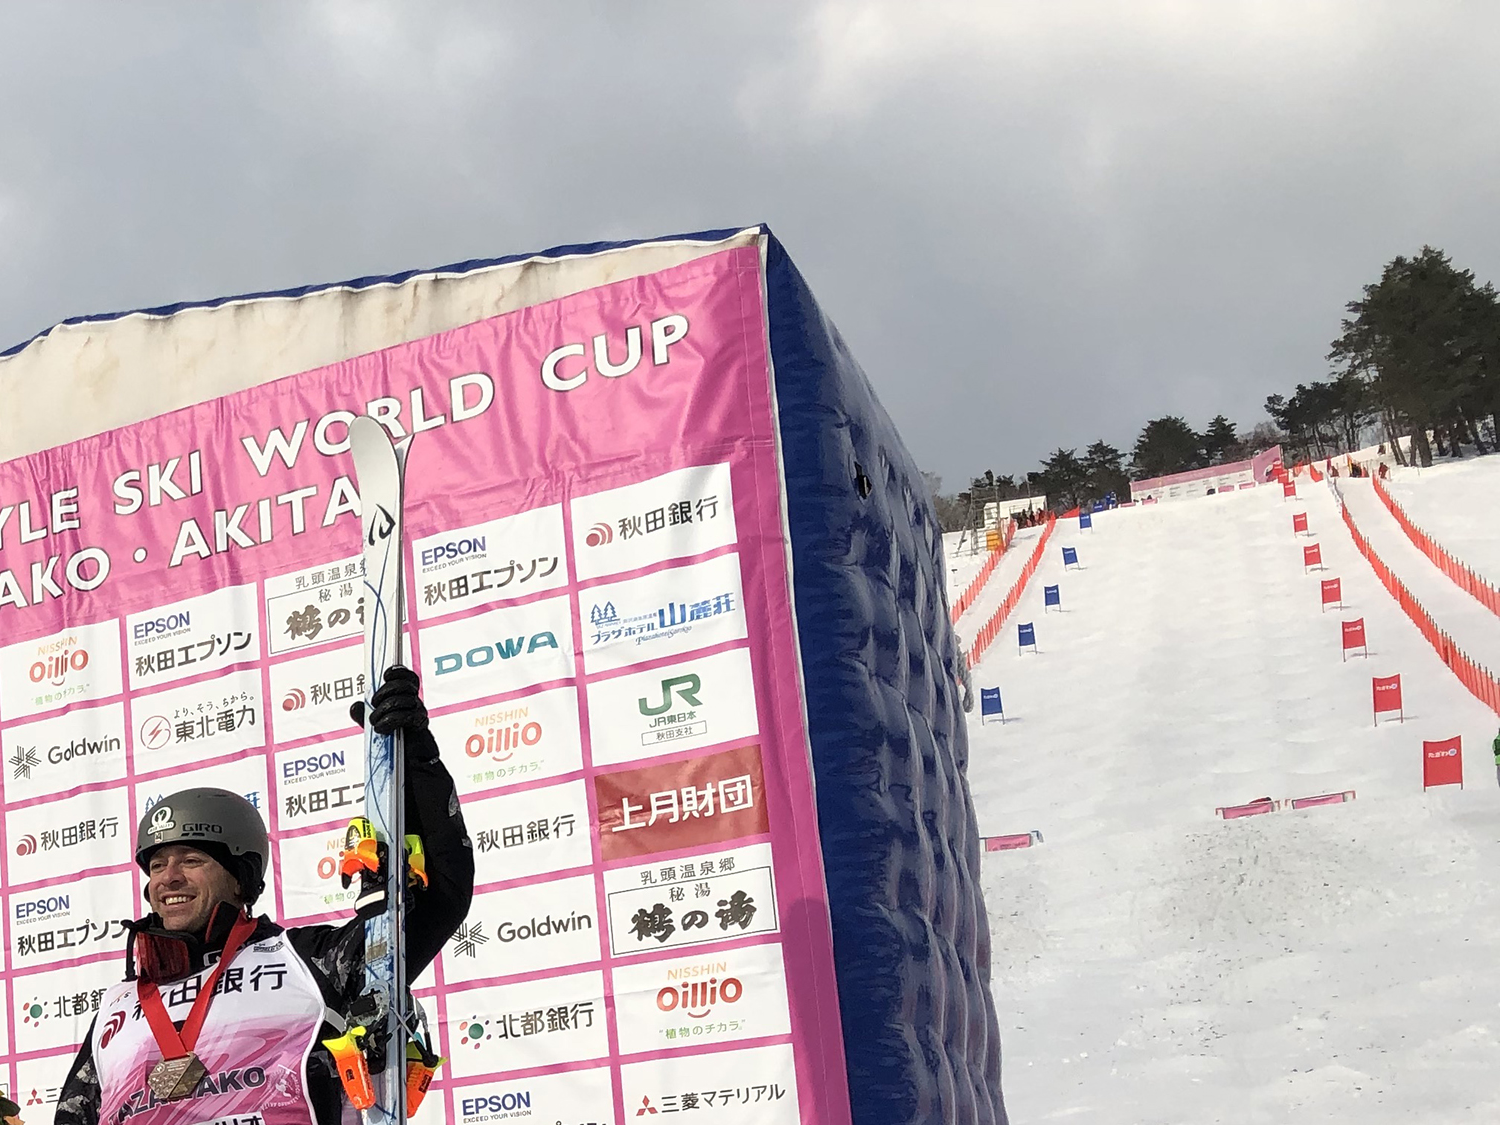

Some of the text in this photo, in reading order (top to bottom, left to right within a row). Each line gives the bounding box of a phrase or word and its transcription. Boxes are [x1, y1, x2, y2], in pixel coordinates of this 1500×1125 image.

[113, 447, 202, 517] SKI
[239, 370, 494, 477] WORLD
[539, 313, 689, 392] CUP
[167, 475, 362, 568] AKITA
[618, 495, 718, 541] 秋田銀行
[421, 535, 486, 567] EPSON
[424, 556, 559, 606] 秋田エプソン
[133, 611, 190, 640] EPSON
[37, 636, 77, 656] NISSHIN
[135, 631, 251, 677] 秋田エプソン
[435, 631, 559, 676] DOWA
[638, 673, 703, 716] JR
[175, 705, 256, 744] 東北電力
[475, 707, 528, 728] NISSHIN
[649, 710, 697, 728] JR東日本
[656, 726, 693, 741] 秋田支社
[48, 734, 120, 765] Goldwin
[283, 751, 345, 778] EPSON
[611, 774, 754, 833] 上月財団
[40, 816, 119, 851] 秋田銀行
[182, 823, 222, 833] GIRO
[477, 814, 576, 853] 秋田銀行
[640, 856, 735, 885] 乳頭温泉郷
[15, 895, 70, 919] EPSON
[17, 919, 130, 957] 秋田エプソン
[497, 911, 592, 943] Goldwin
[667, 961, 727, 981] NISSHIN
[496, 1001, 594, 1040] 北都銀行
[462, 1091, 531, 1116] EPSON
[661, 1083, 786, 1114] 三菱マテリアル
